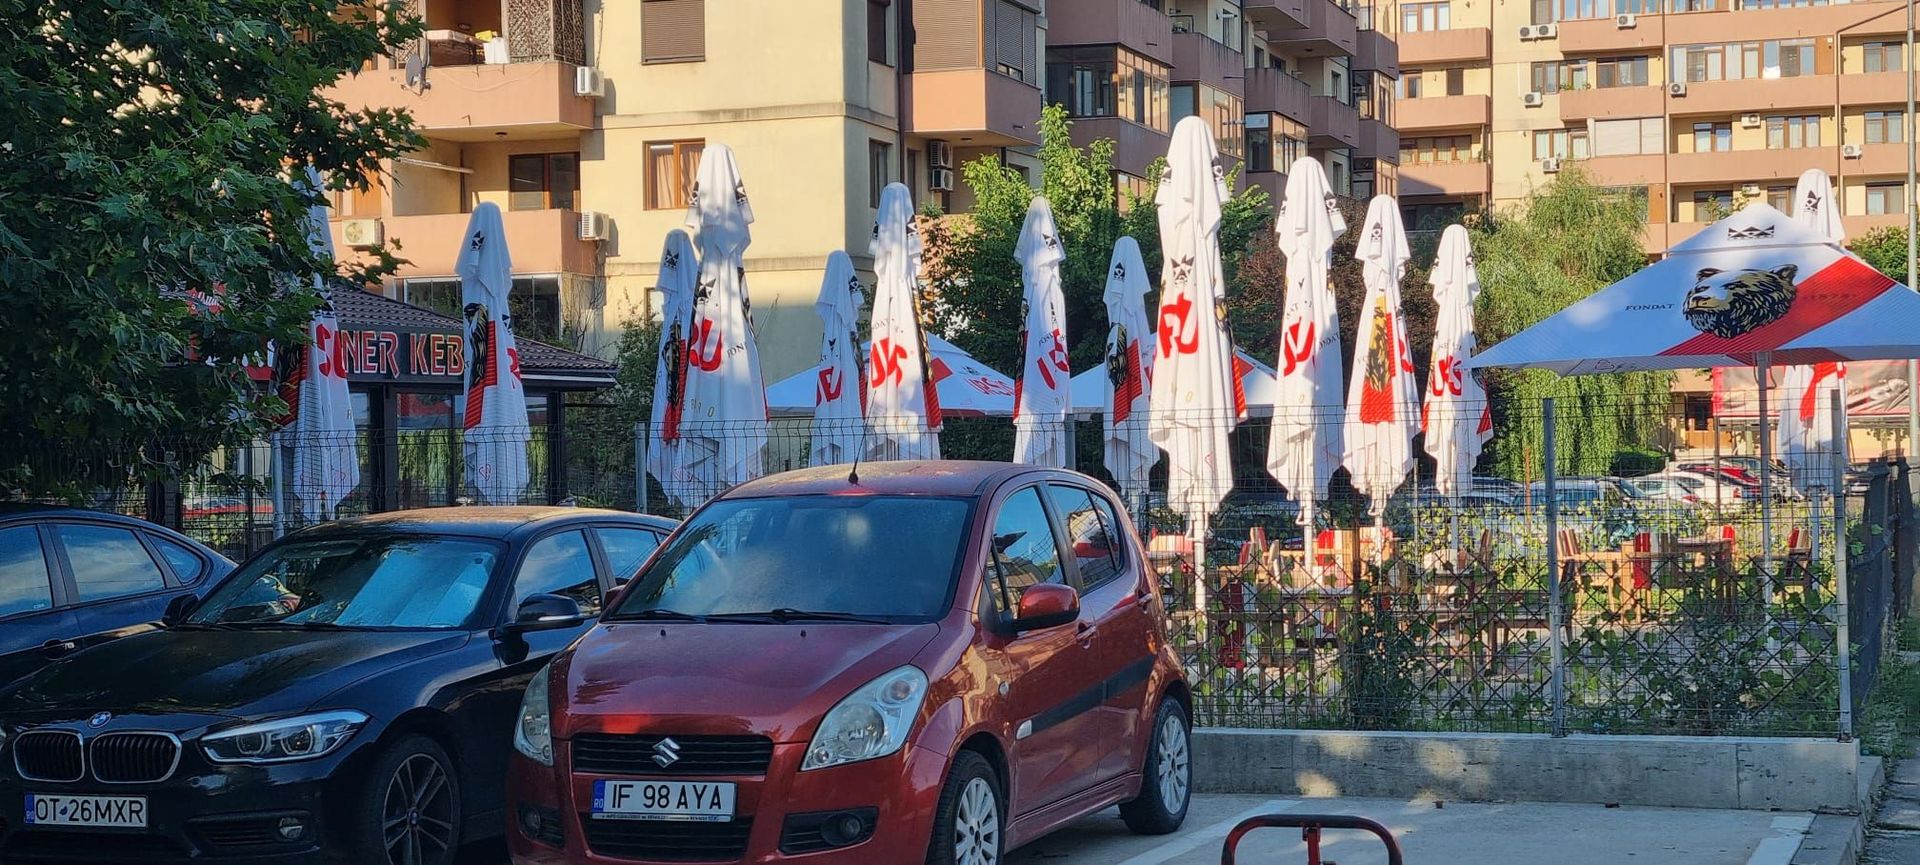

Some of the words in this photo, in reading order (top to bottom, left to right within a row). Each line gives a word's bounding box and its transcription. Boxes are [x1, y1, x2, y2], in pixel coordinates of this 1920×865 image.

[1625, 303, 1675, 312] FONDAT
[340, 330, 400, 379] NER
[410, 333, 465, 377] KEB
[593, 798, 604, 809] RO
[612, 784, 634, 809] IF
[643, 785, 670, 809] 98
[676, 785, 722, 810] AYA
